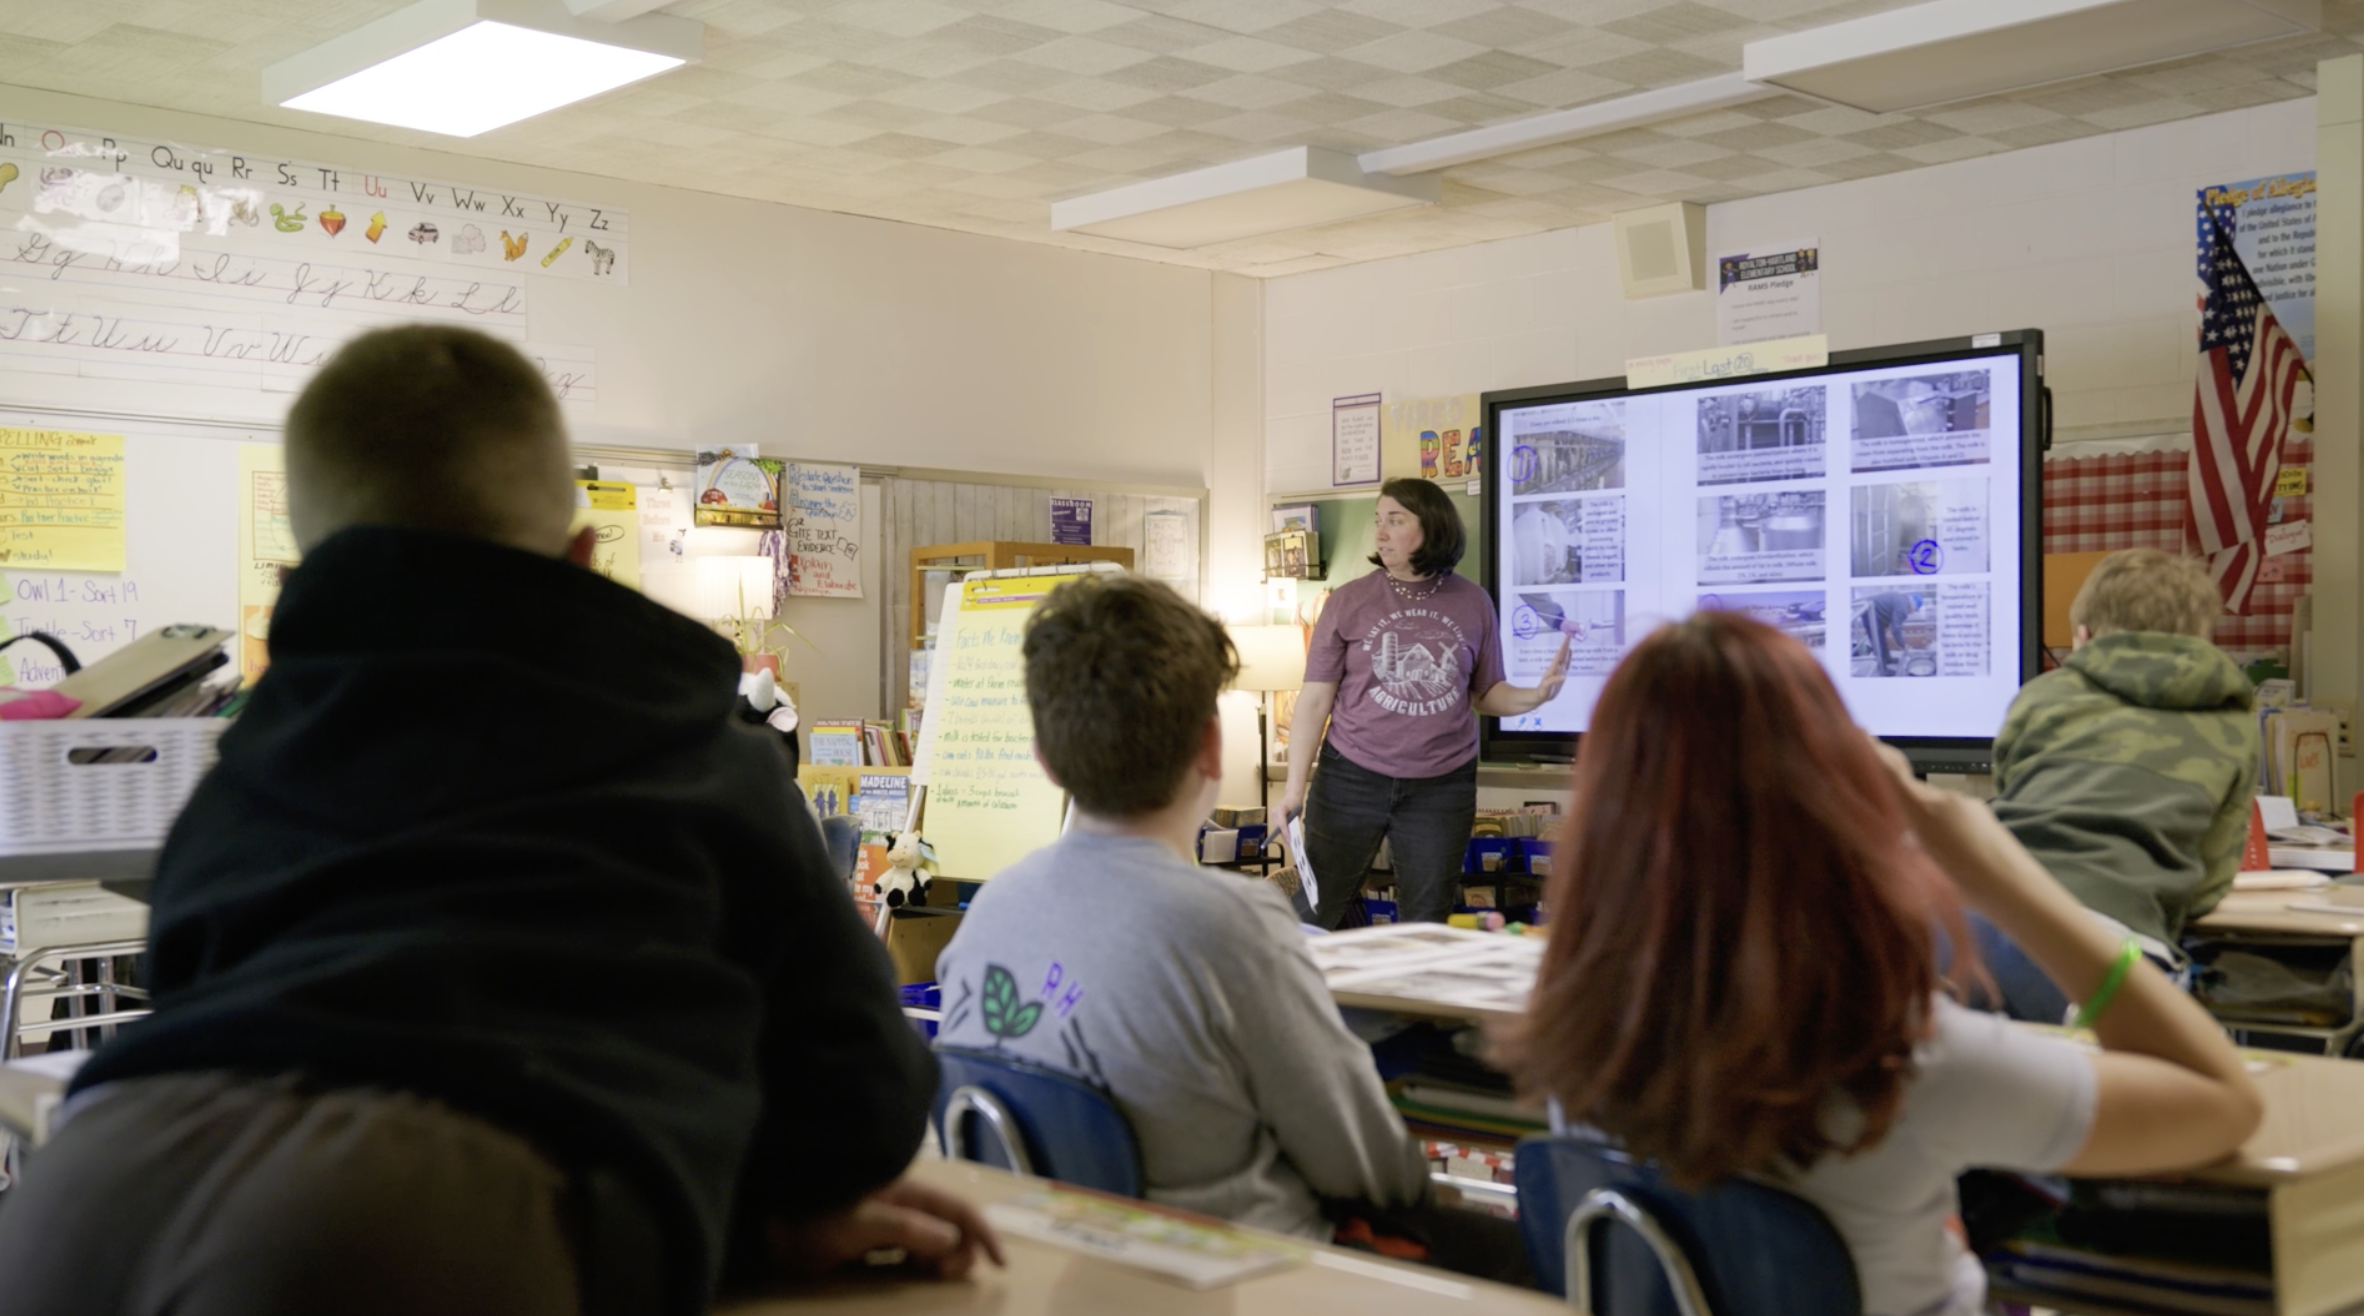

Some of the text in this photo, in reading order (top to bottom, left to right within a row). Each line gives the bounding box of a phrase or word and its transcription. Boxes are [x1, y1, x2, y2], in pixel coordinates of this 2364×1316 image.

[151, 146, 184, 170] Qu
[191, 160, 213, 183] qu
[232, 157, 253, 180] Rr
[278, 163, 297, 187] Ss
[318, 168, 340, 191] Tt
[364, 175, 387, 198] Uu
[410, 181, 435, 204] Vv
[451, 187, 486, 212] Ww
[501, 195, 524, 218] Xx
[546, 202, 568, 233] Yy
[590, 208, 609, 231] Zz
[2206, 185, 2248, 208] Pledge
[2251, 181, 2266, 201] of
[2247, 207, 2268, 218] pledge
[2269, 202, 2303, 214] allegiance
[2304, 201, 2312, 209] to
[2247, 222, 2257, 231] the
[2259, 219, 2279, 230] United
[2281, 217, 2302, 227] States
[2258, 235, 2270, 244] and
[2272, 234, 2278, 242] to
[2280, 232, 2291, 241] the
[2257, 250, 2267, 259] for
[2269, 248, 2288, 257] which
[1775, 263, 1797, 275] SCHOOL
[2266, 263, 2287, 272] Nation
[2289, 260, 2308, 269] under
[1748, 280, 1794, 291] RAMS Pledge
[2289, 275, 2303, 284] with
[2274, 288, 2308, 302] justice for
[1703, 357, 1732, 376] Last
[815, 528, 839, 541] TEXT
[17, 578, 50, 602] Owl
[82, 579, 117, 604] Sort
[1389, 610, 1403, 621] WE
[1404, 608, 1428, 618] WEAR
[1441, 615, 1454, 628] WE
[81, 620, 117, 642] Sort
[1368, 685, 1460, 717] AGRICULTURE
[861, 775, 906, 789] MADELINE
